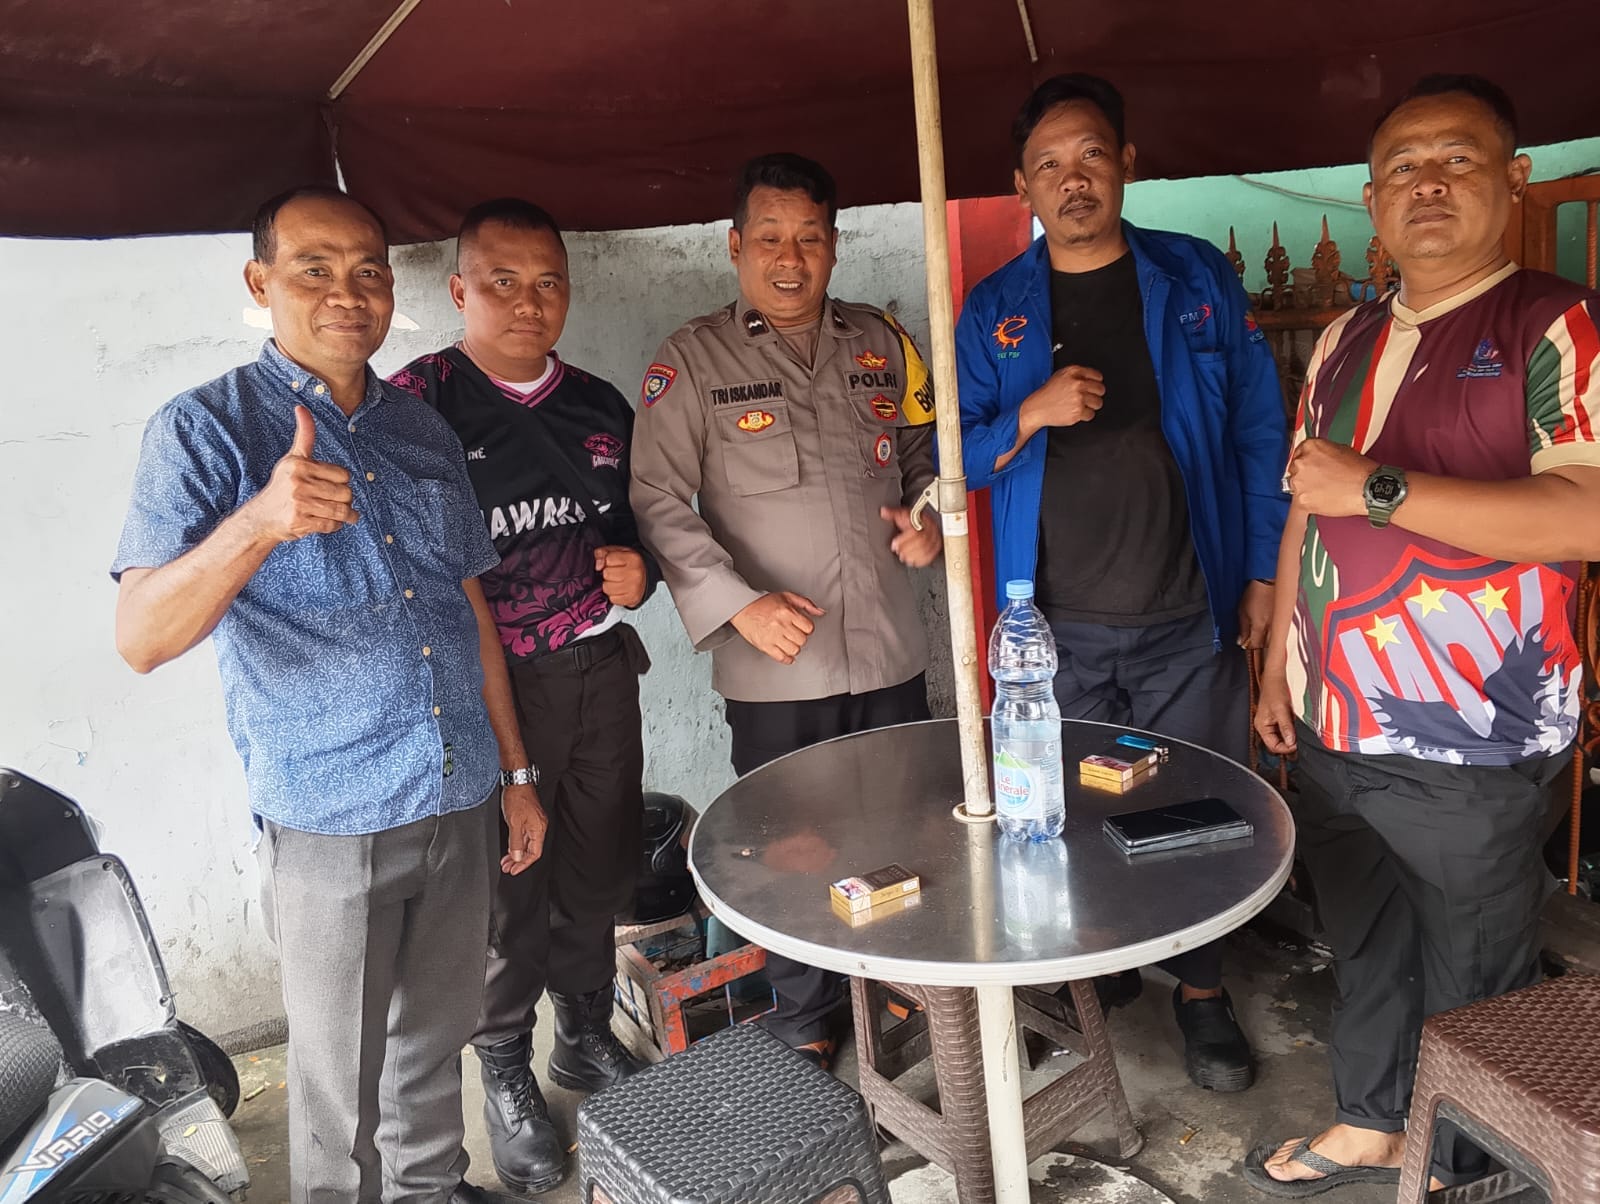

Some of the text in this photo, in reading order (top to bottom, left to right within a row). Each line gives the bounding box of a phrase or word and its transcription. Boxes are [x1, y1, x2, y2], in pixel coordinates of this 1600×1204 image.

[710, 381, 783, 406] TRI ISKANDAR
[848, 372, 898, 390] POLRI
[5, 1109, 113, 1175] VARIO
